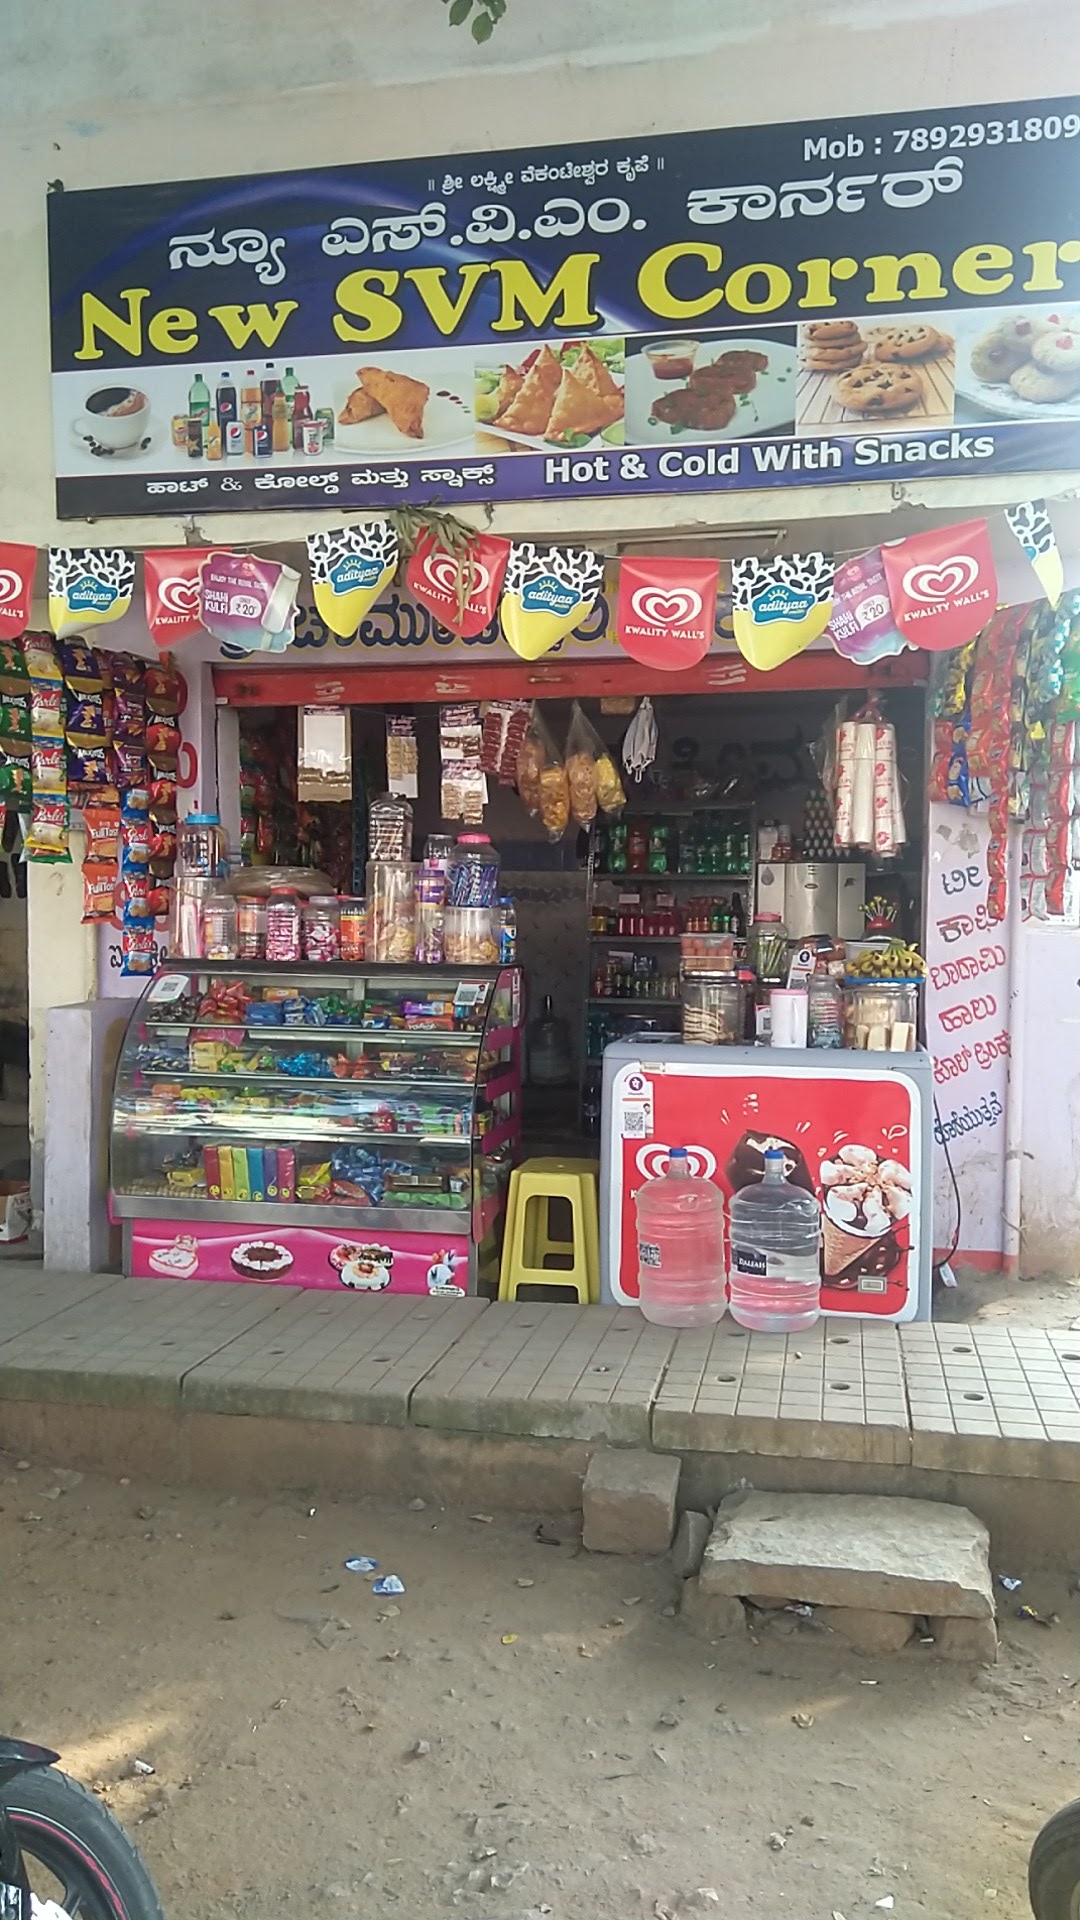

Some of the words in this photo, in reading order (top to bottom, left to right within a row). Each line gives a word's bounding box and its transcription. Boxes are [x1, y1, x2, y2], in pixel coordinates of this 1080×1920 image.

[803, 134, 865, 162] Mob
[892, 114, 1080, 154] 7892931809
[441, 174, 464, 195] ಶ್ರೀ
[168, 226, 287, 286] ನ್ಯೂ
[686, 155, 965, 226] ಕಾರ್ನರ್
[74, 288, 299, 361] New
[332, 252, 601, 344] SVM
[637, 239, 1080, 321] Corner
[544, 455, 609, 484] Hot
[619, 455, 648, 480] &
[658, 447, 740, 478] Cold
[752, 441, 842, 472] With
[854, 432, 995, 466] Snacks
[146, 476, 209, 495] ಹಾಟ್
[220, 476, 243, 492] &
[254, 471, 340, 495] ಕೋಲ್ಡ್
[351, 467, 410, 488] ಮತ್ತು
[204, 589, 229, 603] SHAHI
[413, 582, 453, 605] KWALITY
[903, 602, 951, 622] KWALITY
[953, 589, 990, 607] WALL'S
[205, 600, 229, 614] KULFI
[155, 615, 190, 626] KWALITY
[624, 625, 668, 638] KWALITY
[671, 629, 706, 640] WALL'S
[828, 610, 854, 631] SHAHI
[833, 620, 860, 641] KULFI
[941, 865, 984, 896] ಟೀ
[938, 994, 998, 1033] ಹಾಲು
